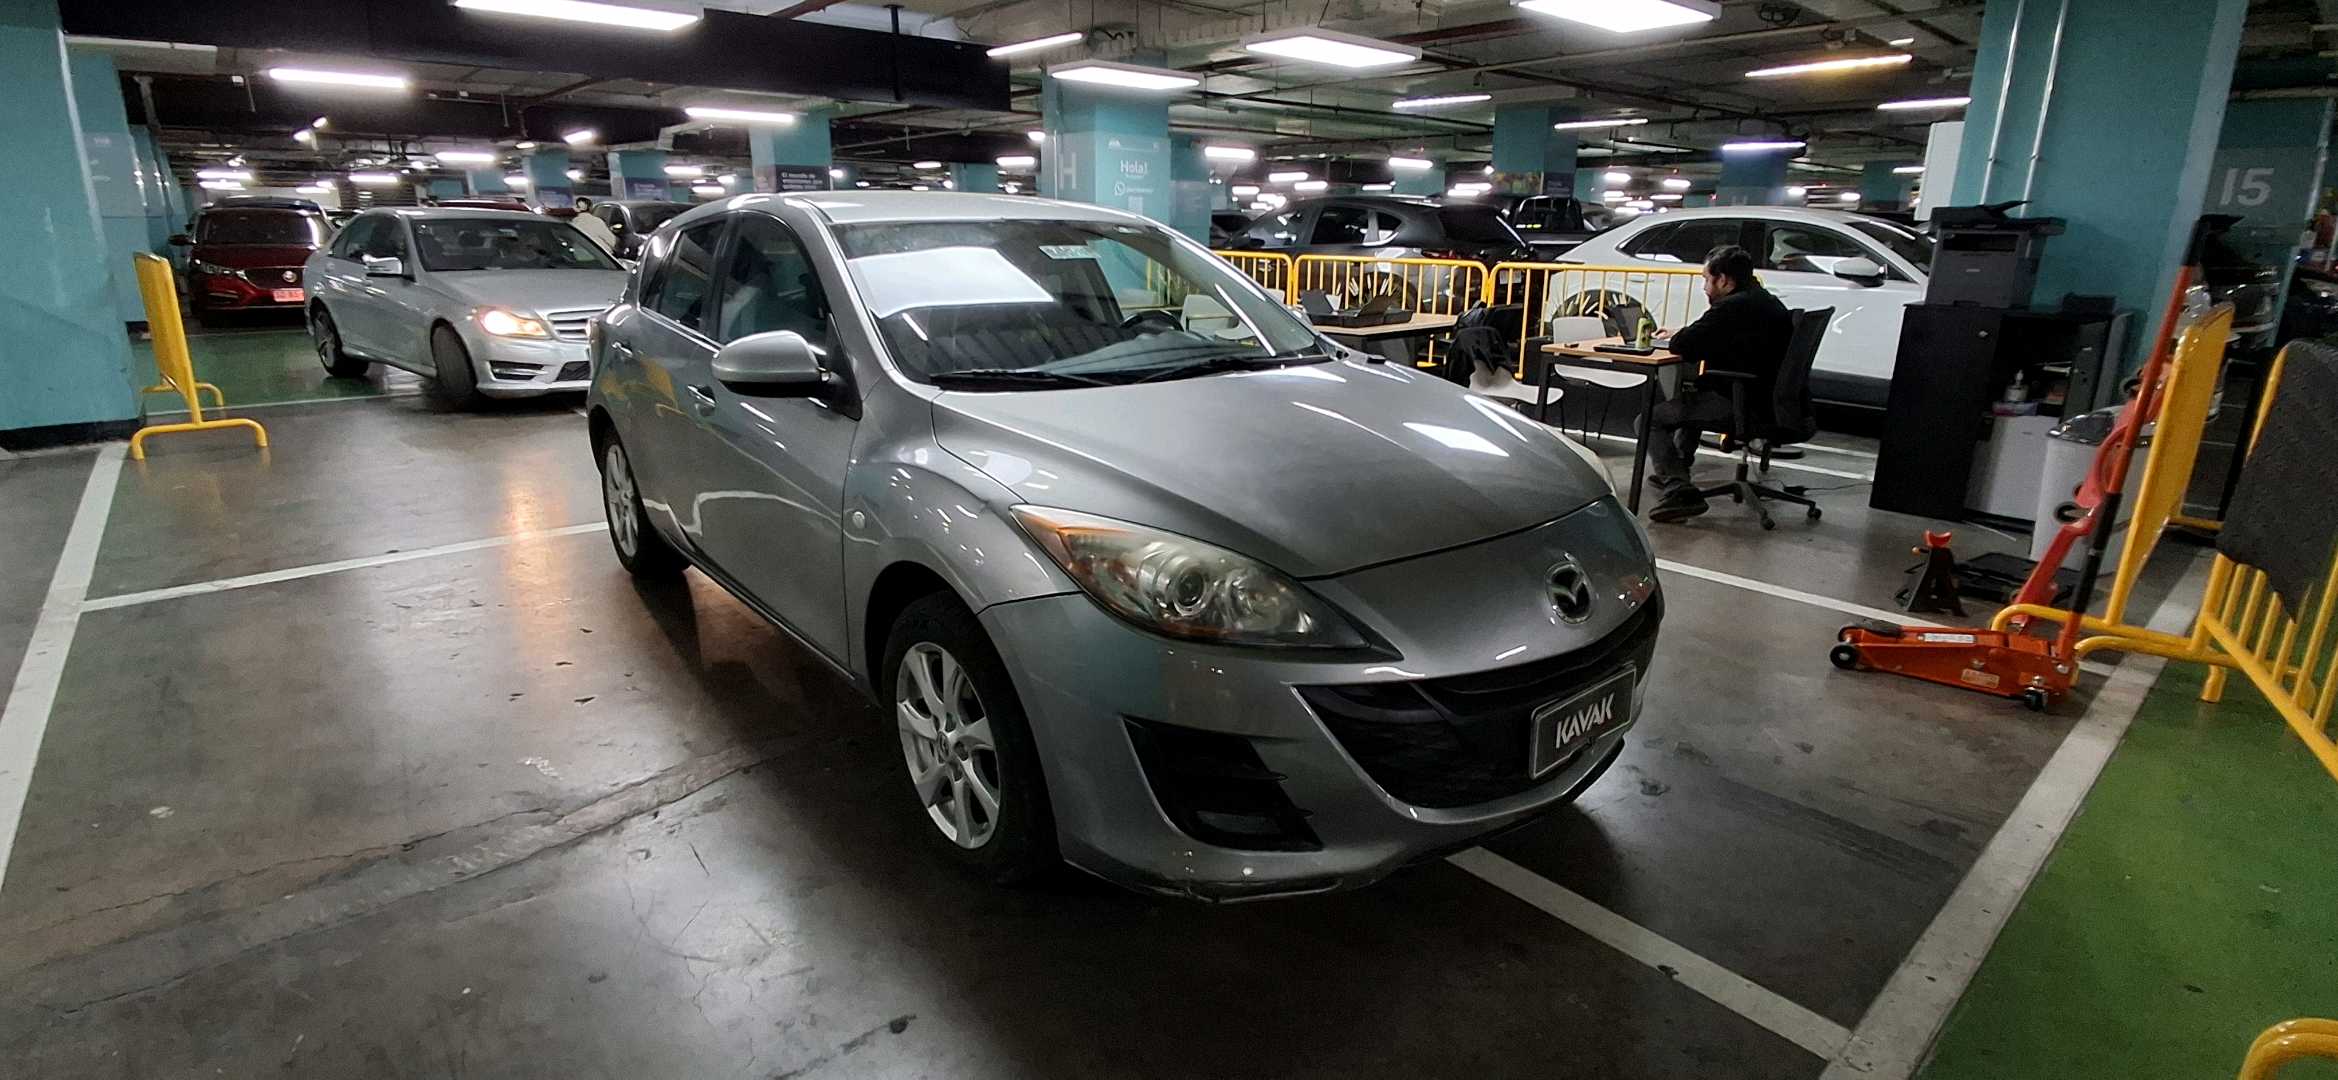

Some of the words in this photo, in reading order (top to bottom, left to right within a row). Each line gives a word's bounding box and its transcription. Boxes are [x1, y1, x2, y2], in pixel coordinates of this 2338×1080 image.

[1119, 159, 1148, 175] Hola!
[2219, 168, 2275, 206] 15
[1555, 692, 1615, 749] KAVAK
